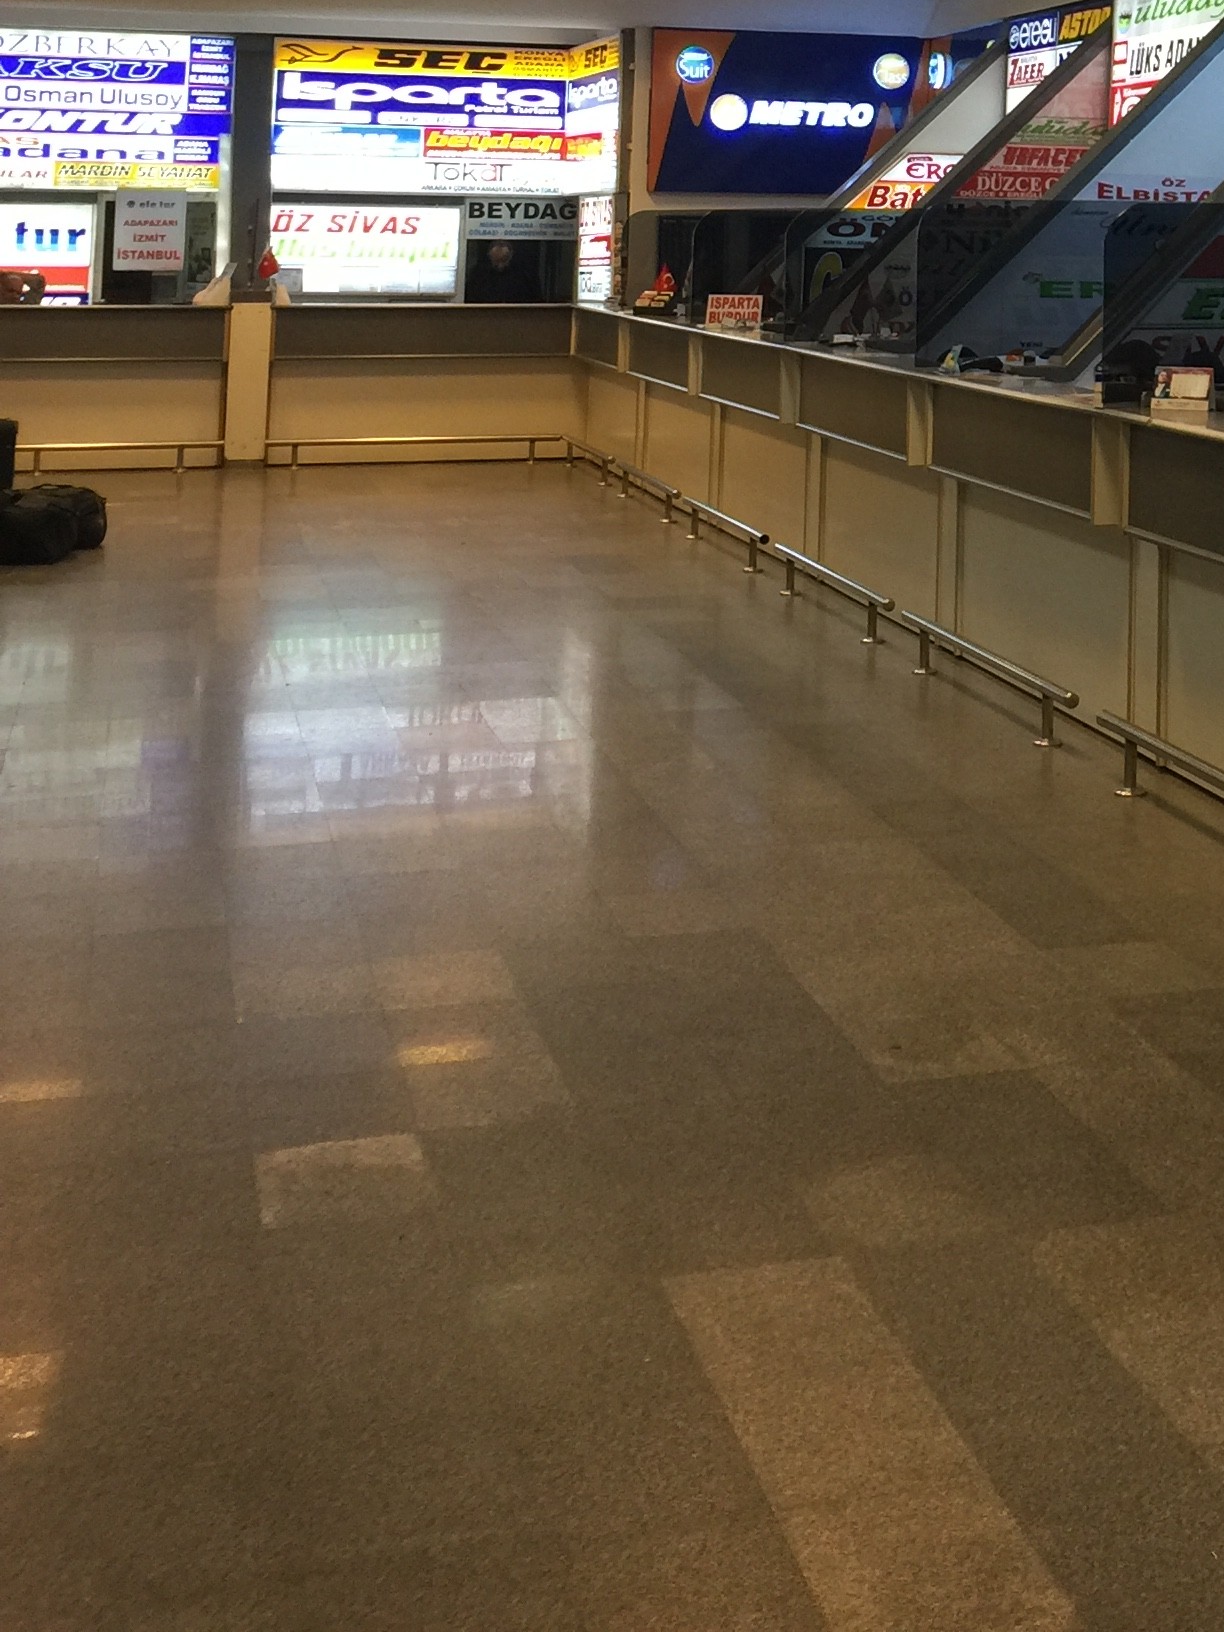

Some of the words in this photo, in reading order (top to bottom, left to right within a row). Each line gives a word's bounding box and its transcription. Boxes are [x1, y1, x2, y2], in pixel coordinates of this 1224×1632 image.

[0, 33, 181, 58] ZBERKAY
[678, 58, 711, 79] Suit
[1129, 42, 1162, 77] LÜKS
[1008, 58, 1045, 86] ZAFER
[4, 84, 94, 105] Osman
[100, 88, 183, 110] Ulusoy
[749, 100, 875, 128] METRO
[976, 170, 1043, 191] DÜZCE
[1161, 177, 1186, 188] ÖZ
[123, 219, 178, 228] ADAPAZARI
[271, 209, 315, 233] ÖZ
[326, 210, 422, 235] SİVAS
[15, 221, 87, 252] tur
[132, 233, 167, 243] İZMİT
[116, 248, 181, 261] İSTANBUL
[709, 297, 760, 310] ISPARTA
